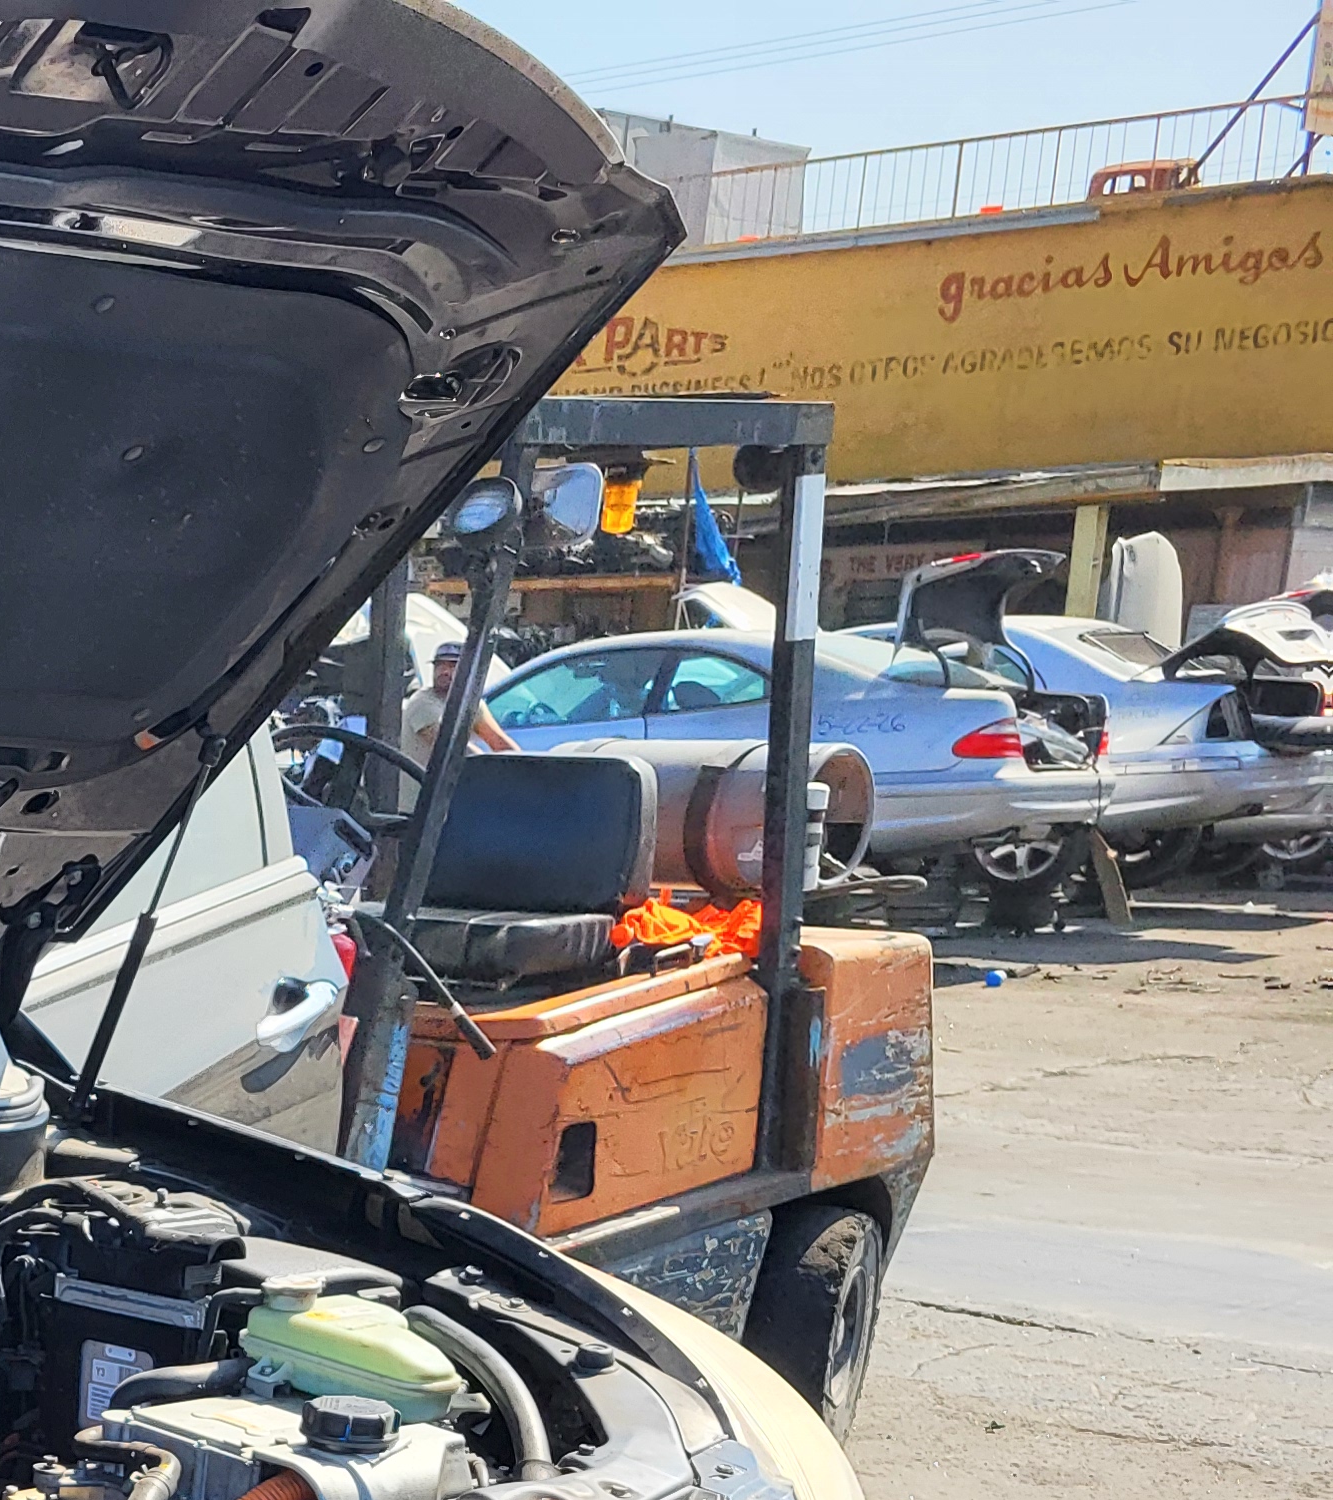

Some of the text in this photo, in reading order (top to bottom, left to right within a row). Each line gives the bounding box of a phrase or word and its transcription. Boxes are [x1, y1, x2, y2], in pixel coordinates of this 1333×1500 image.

[938, 231, 1324, 324] gracias Amigos
[1167, 331, 1202, 355] SU
